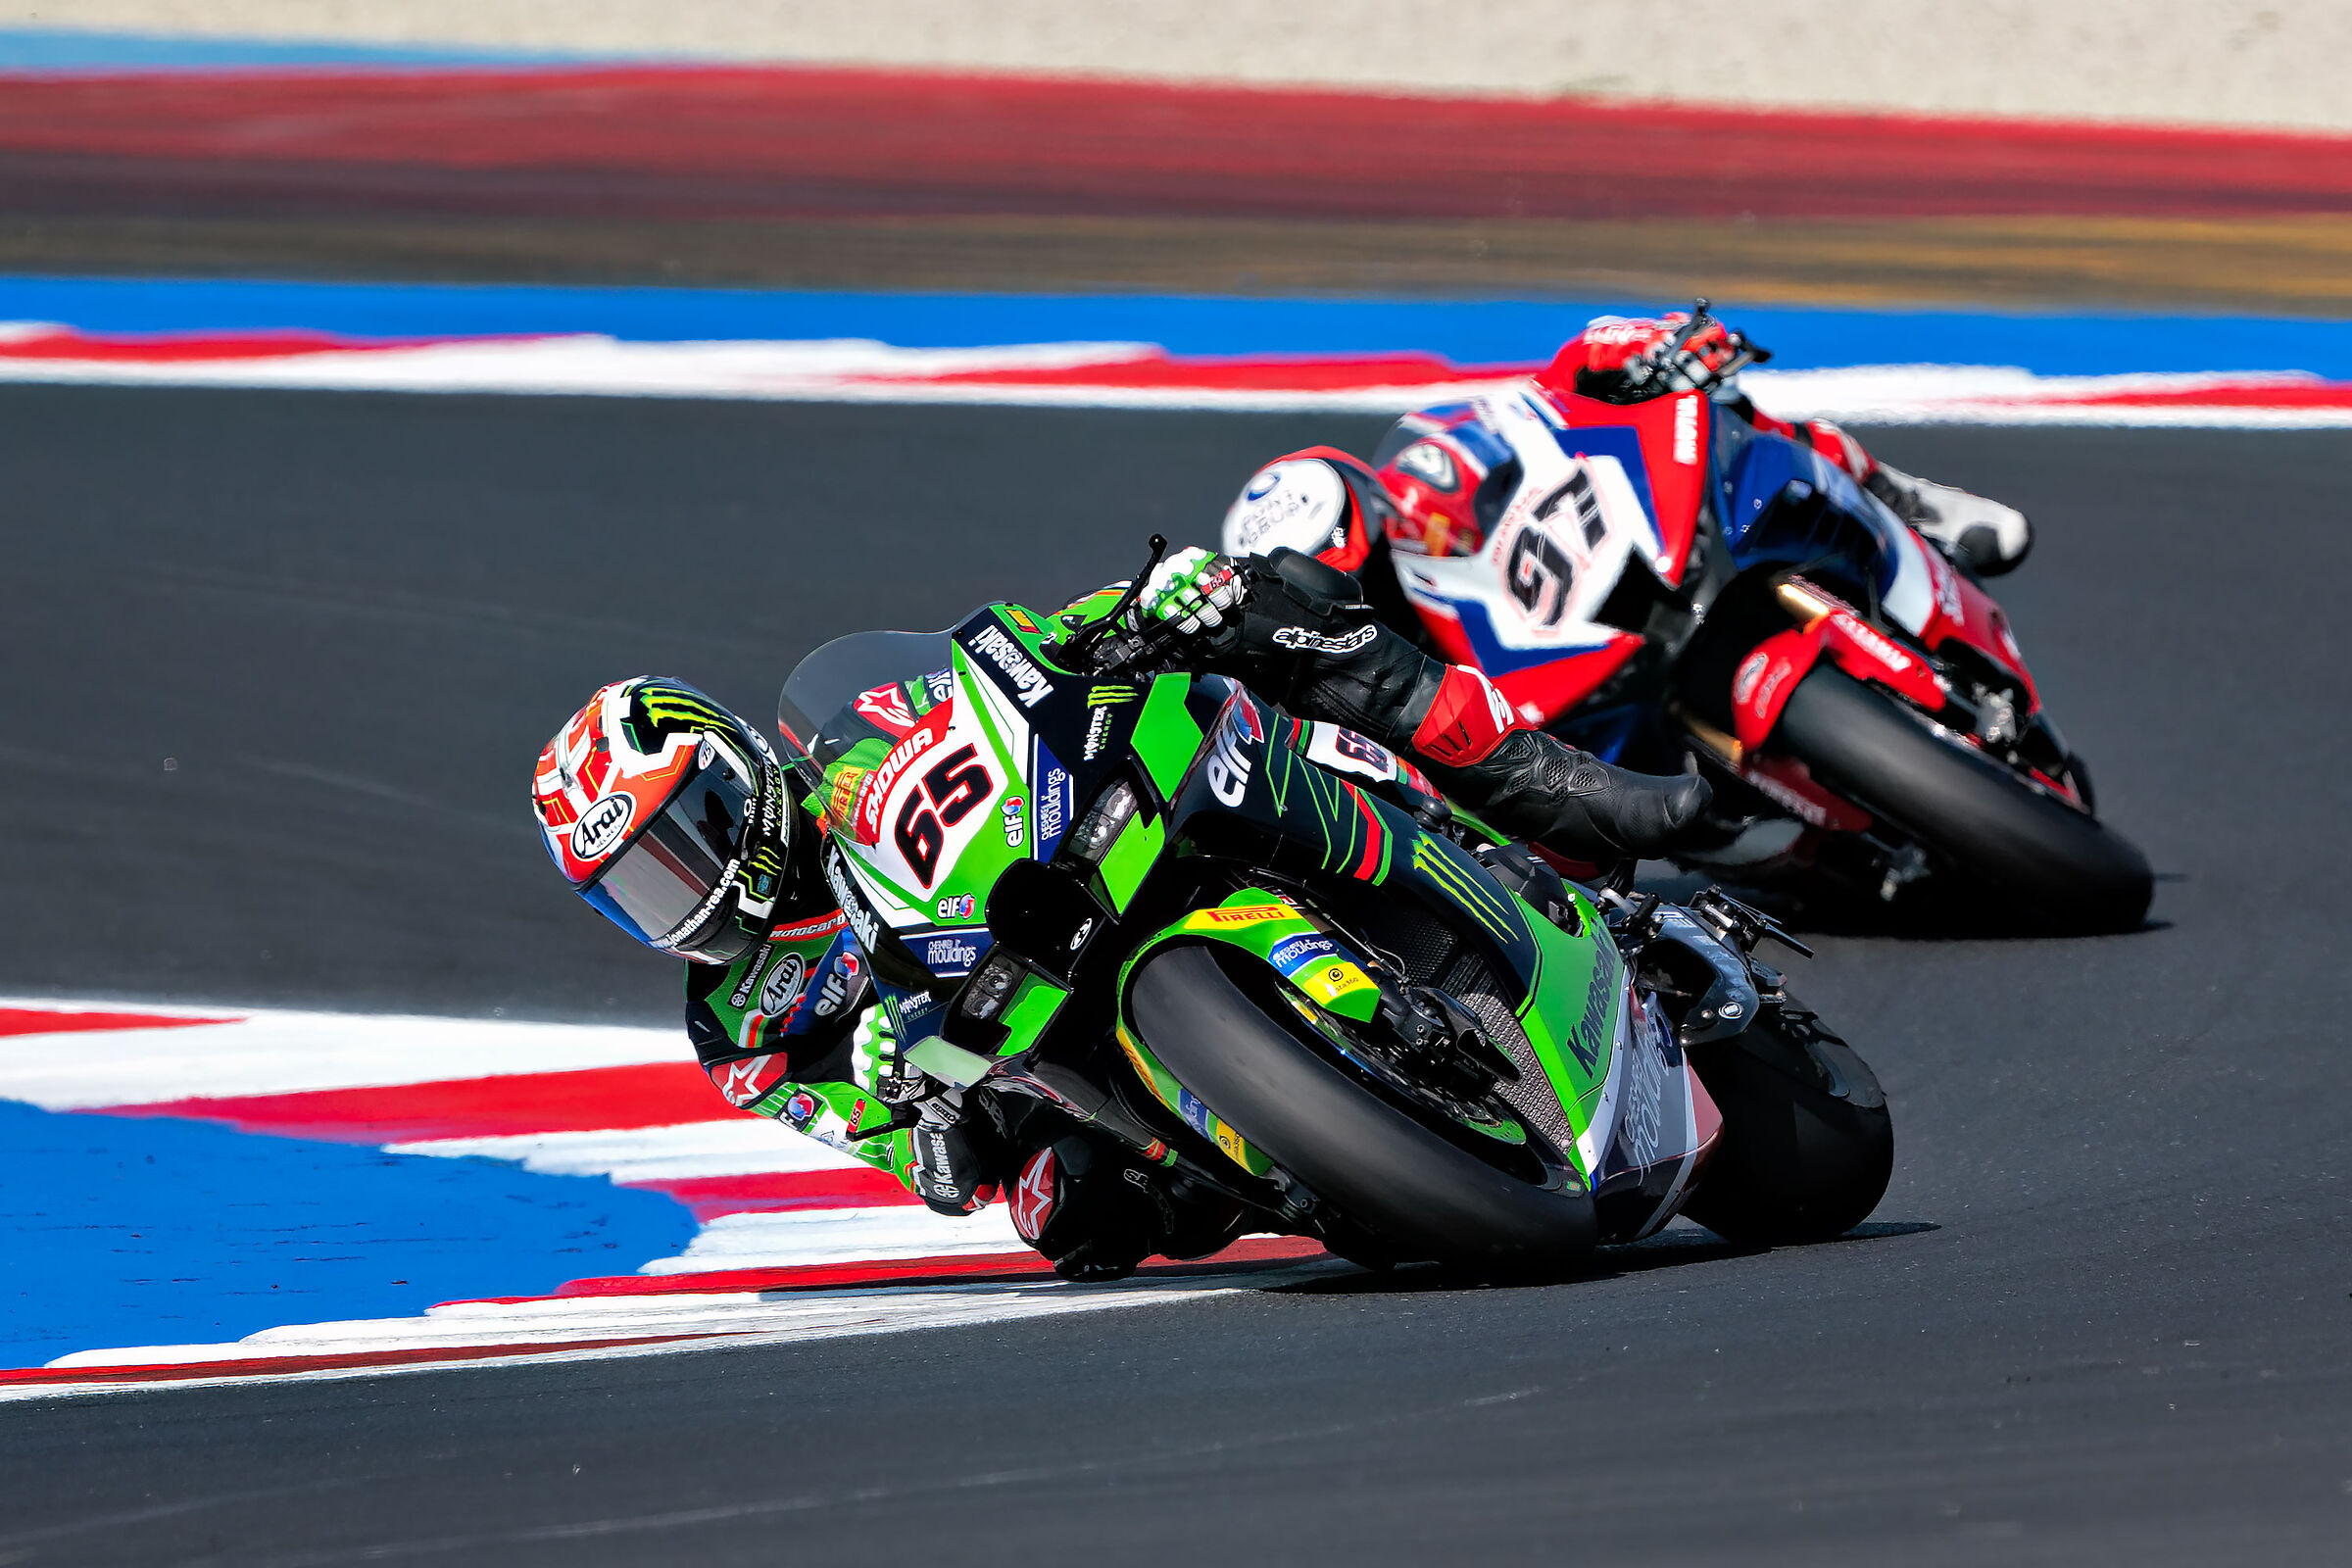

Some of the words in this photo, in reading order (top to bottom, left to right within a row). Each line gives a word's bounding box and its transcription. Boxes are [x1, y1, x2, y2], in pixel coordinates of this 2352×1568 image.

[1505, 467, 1609, 628] 97
[968, 624, 1054, 709] Kawasaki
[1083, 706, 1107, 761] MONSTER
[865, 727, 934, 835] SHOWA
[1041, 767, 1066, 839] mouldings
[581, 797, 624, 857] Arai
[894, 742, 994, 890] 65
[1003, 813, 1024, 848] elf
[827, 844, 879, 955] Kawasaki
[937, 896, 961, 919] elf
[1206, 906, 1286, 923] PIRELLI
[740, 943, 772, 994] Kawasaki
[1276, 939, 1333, 968] mouldings
[766, 958, 799, 1012] Arai
[813, 973, 847, 1016] elf
[1567, 916, 1618, 1079] Kawasaki
[850, 1109, 861, 1125] 65
[930, 1132, 954, 1185] Kawasa
